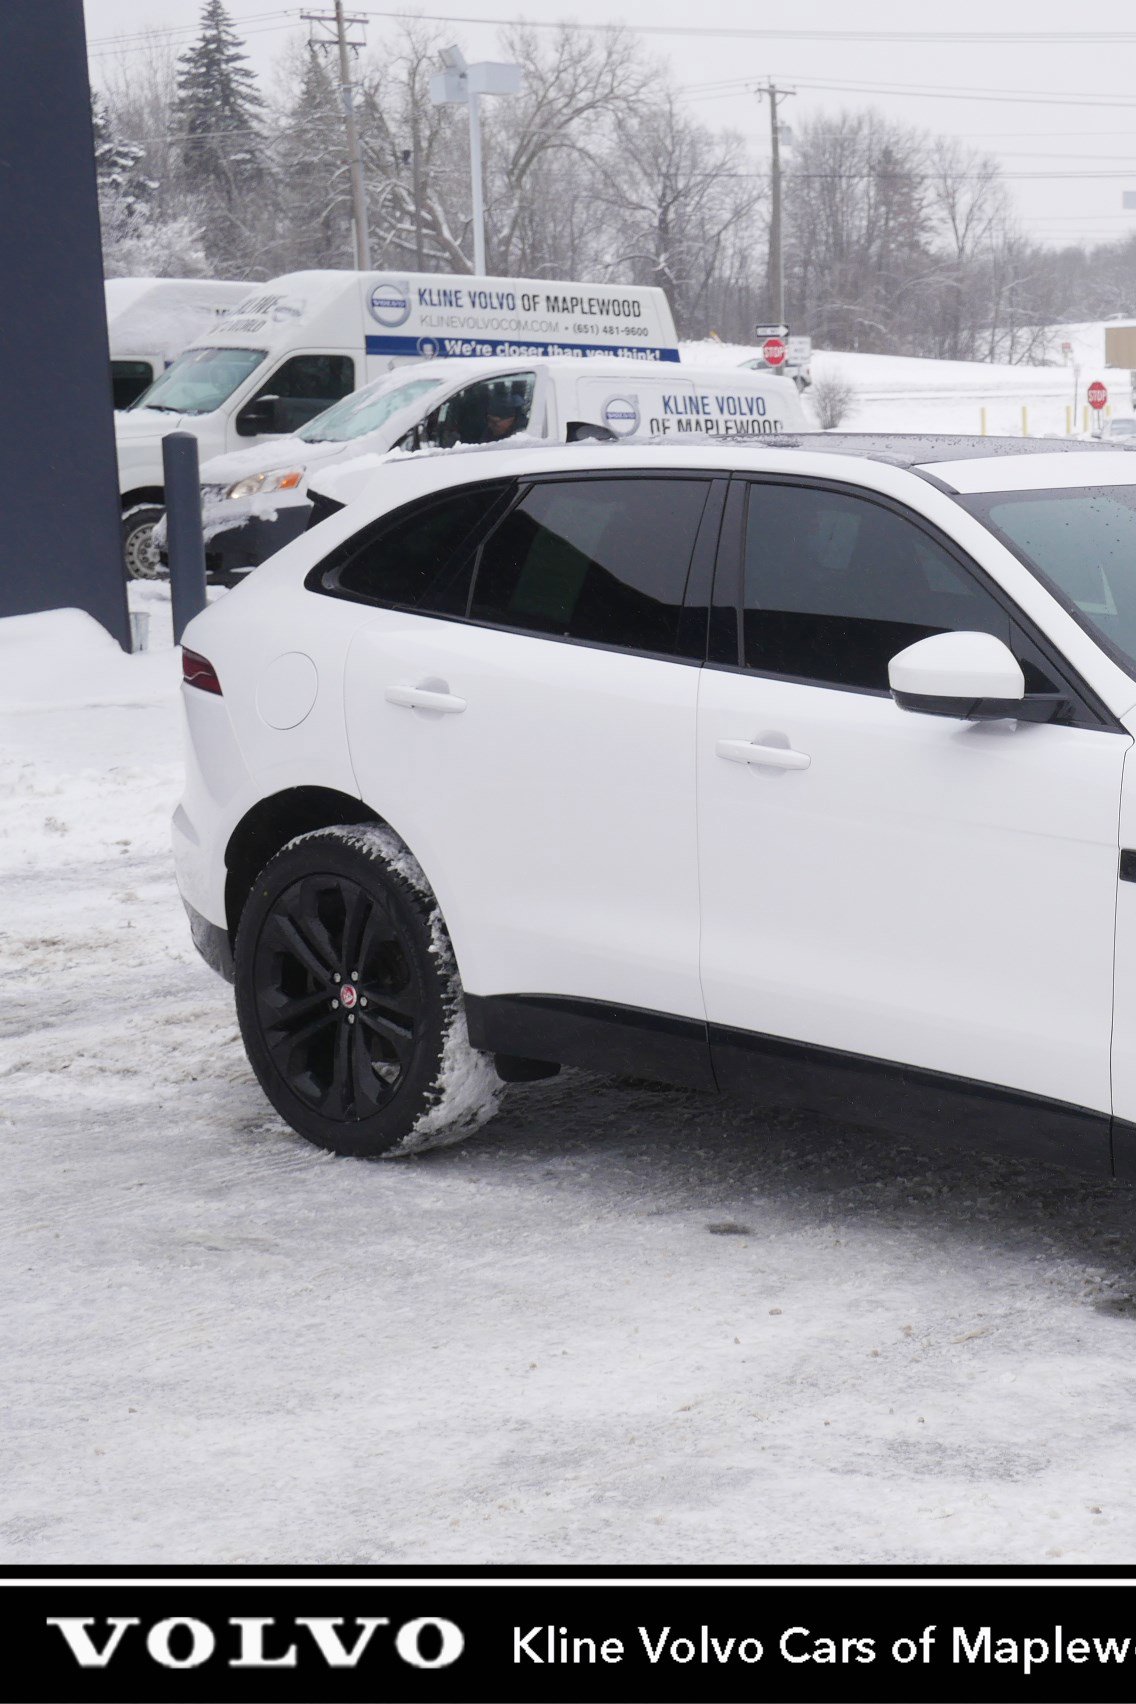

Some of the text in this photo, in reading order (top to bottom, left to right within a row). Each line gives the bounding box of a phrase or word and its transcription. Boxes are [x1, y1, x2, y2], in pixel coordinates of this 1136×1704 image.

[418, 288, 642, 318] KLINE VOLVO OF MAPLEWOOD
[573, 322, 599, 335] (651)
[603, 325, 649, 337] 481-9600
[444, 339, 493, 357] We're
[496, 342, 544, 357] closer
[547, 345, 582, 358] than
[764, 346, 786, 358] STOP
[1088, 389, 1107, 402] STOP
[662, 395, 766, 416] KLINE VOLVO
[650, 418, 671, 434] OF
